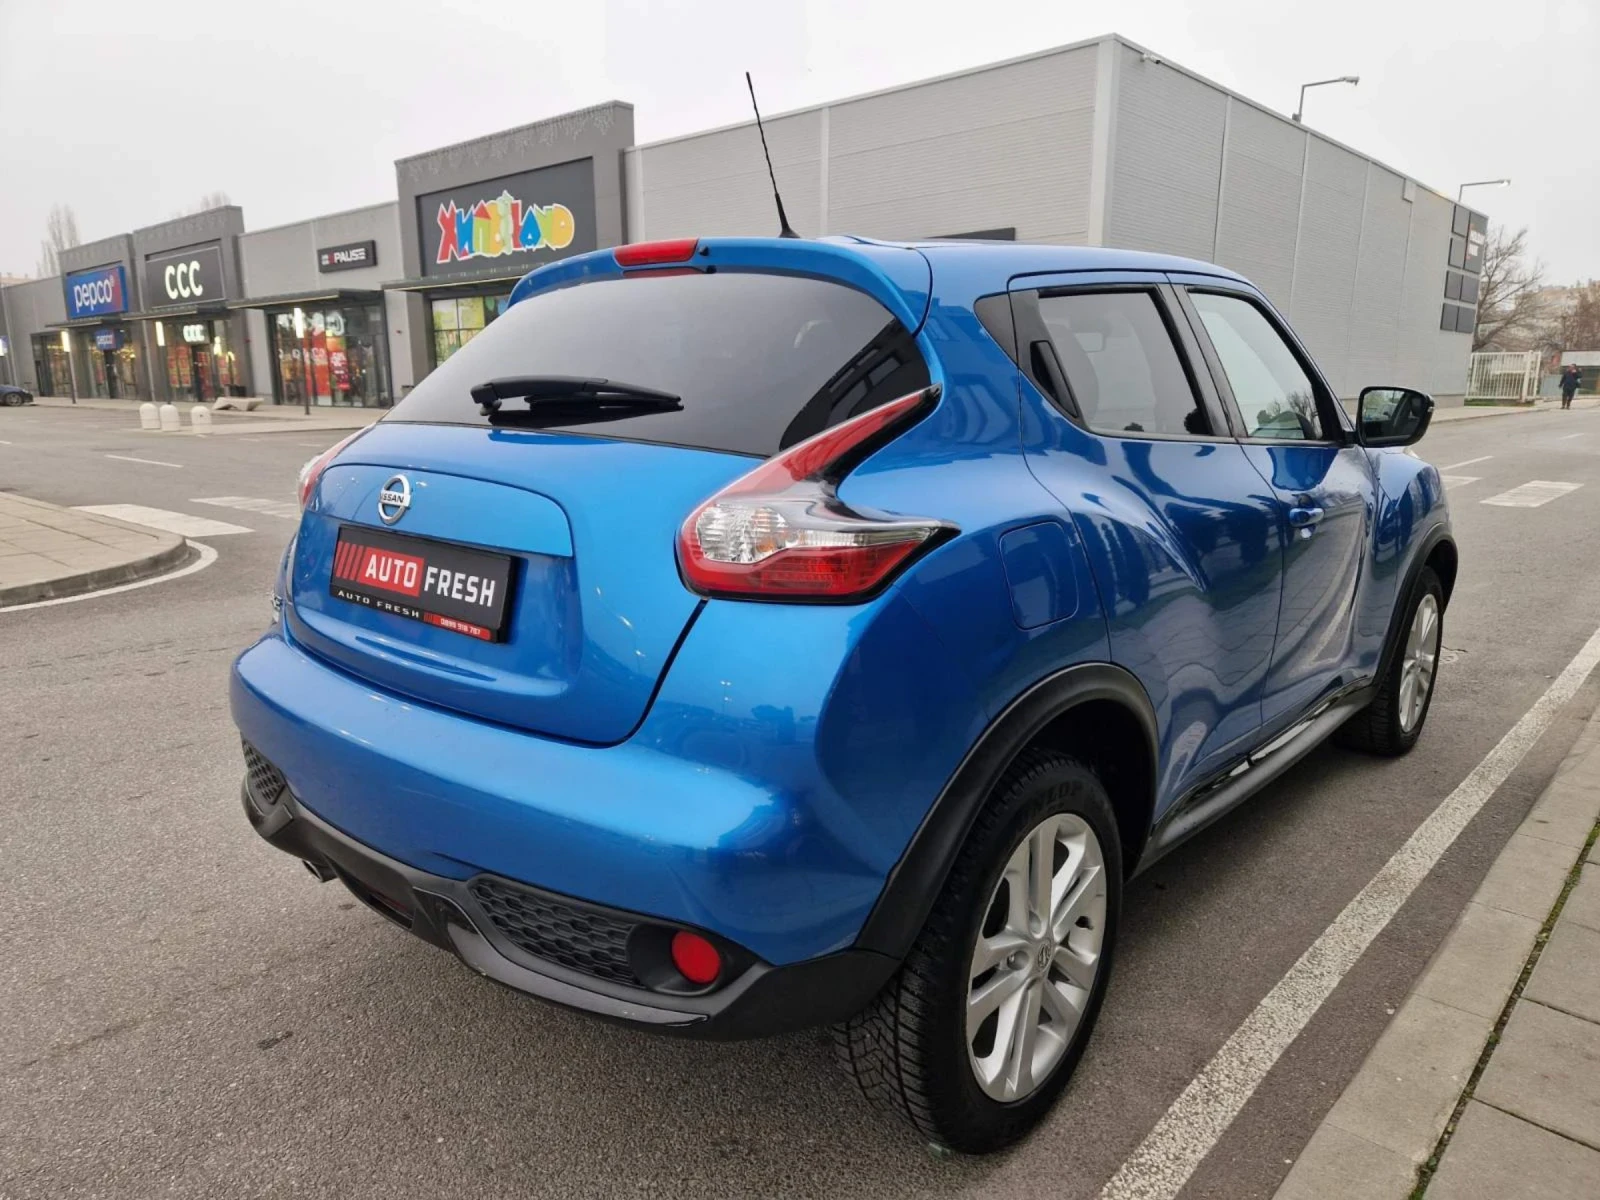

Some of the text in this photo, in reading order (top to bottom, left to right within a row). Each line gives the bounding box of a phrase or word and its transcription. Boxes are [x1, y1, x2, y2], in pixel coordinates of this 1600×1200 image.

[73, 278, 112, 313] pepco
[165, 260, 204, 300] CCC
[365, 554, 496, 607] AUTO FRESH
[337, 590, 419, 618] AUTO FRESH
